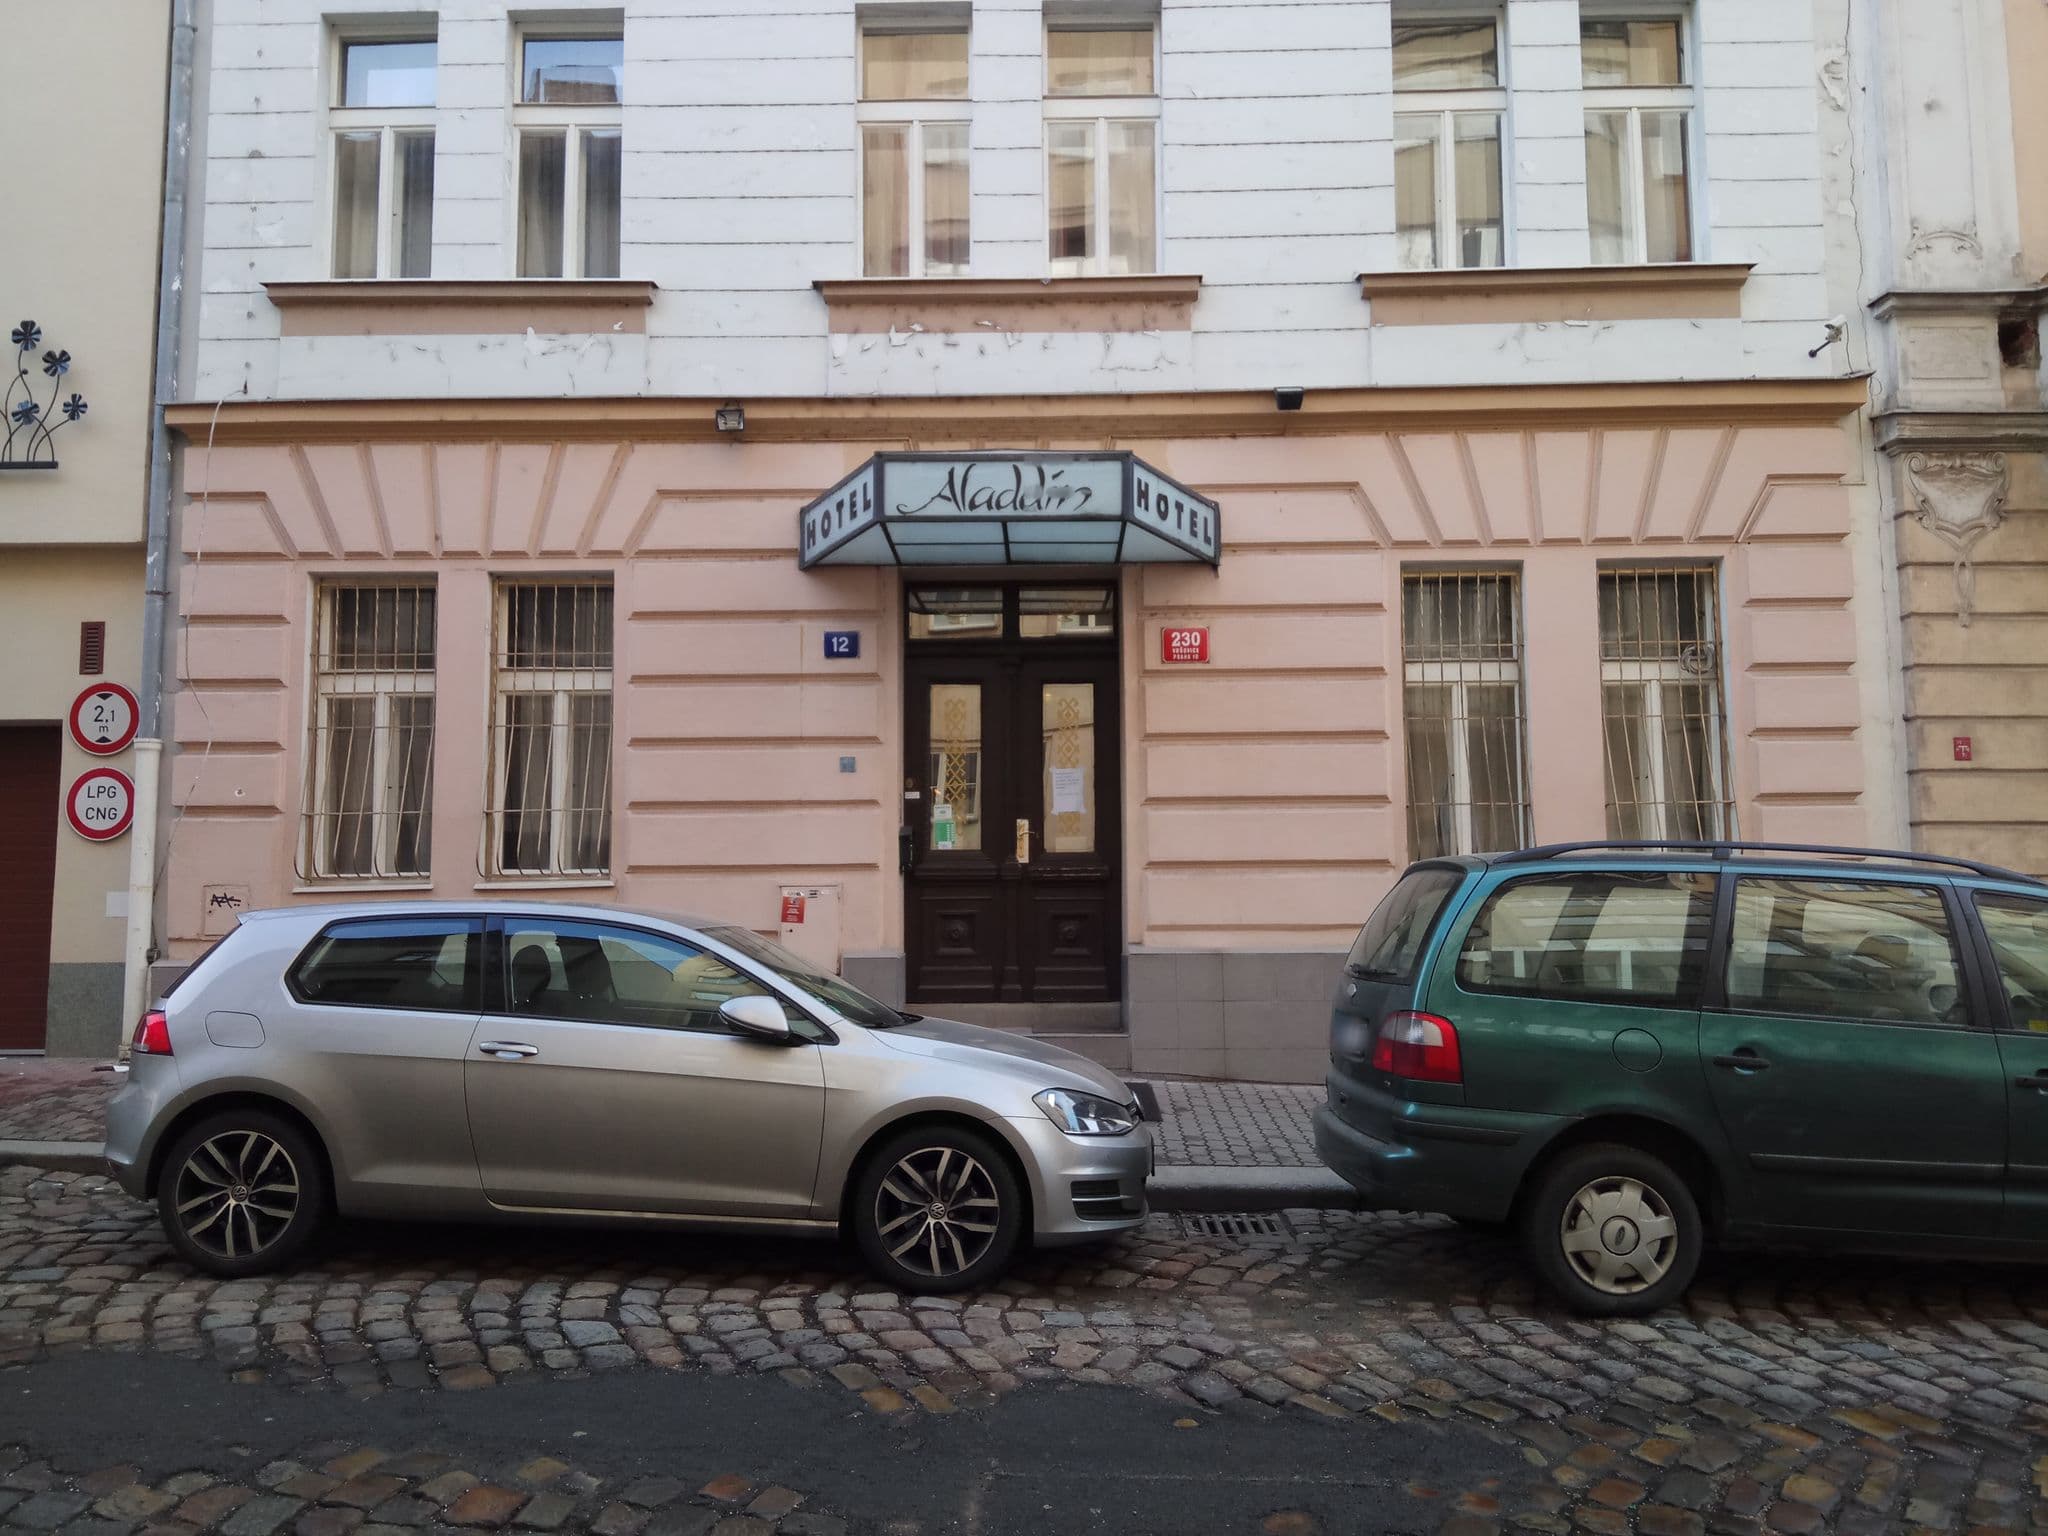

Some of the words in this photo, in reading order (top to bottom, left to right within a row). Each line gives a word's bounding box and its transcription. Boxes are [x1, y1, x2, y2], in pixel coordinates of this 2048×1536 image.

[807, 481, 871, 550] HOTEL
[1137, 477, 1212, 547] HOTEL
[831, 636, 849, 653] 12
[1171, 631, 1201, 647] 230
[98, 725, 109, 733] m
[87, 785, 117, 799] LPG
[85, 806, 118, 821] CNG
